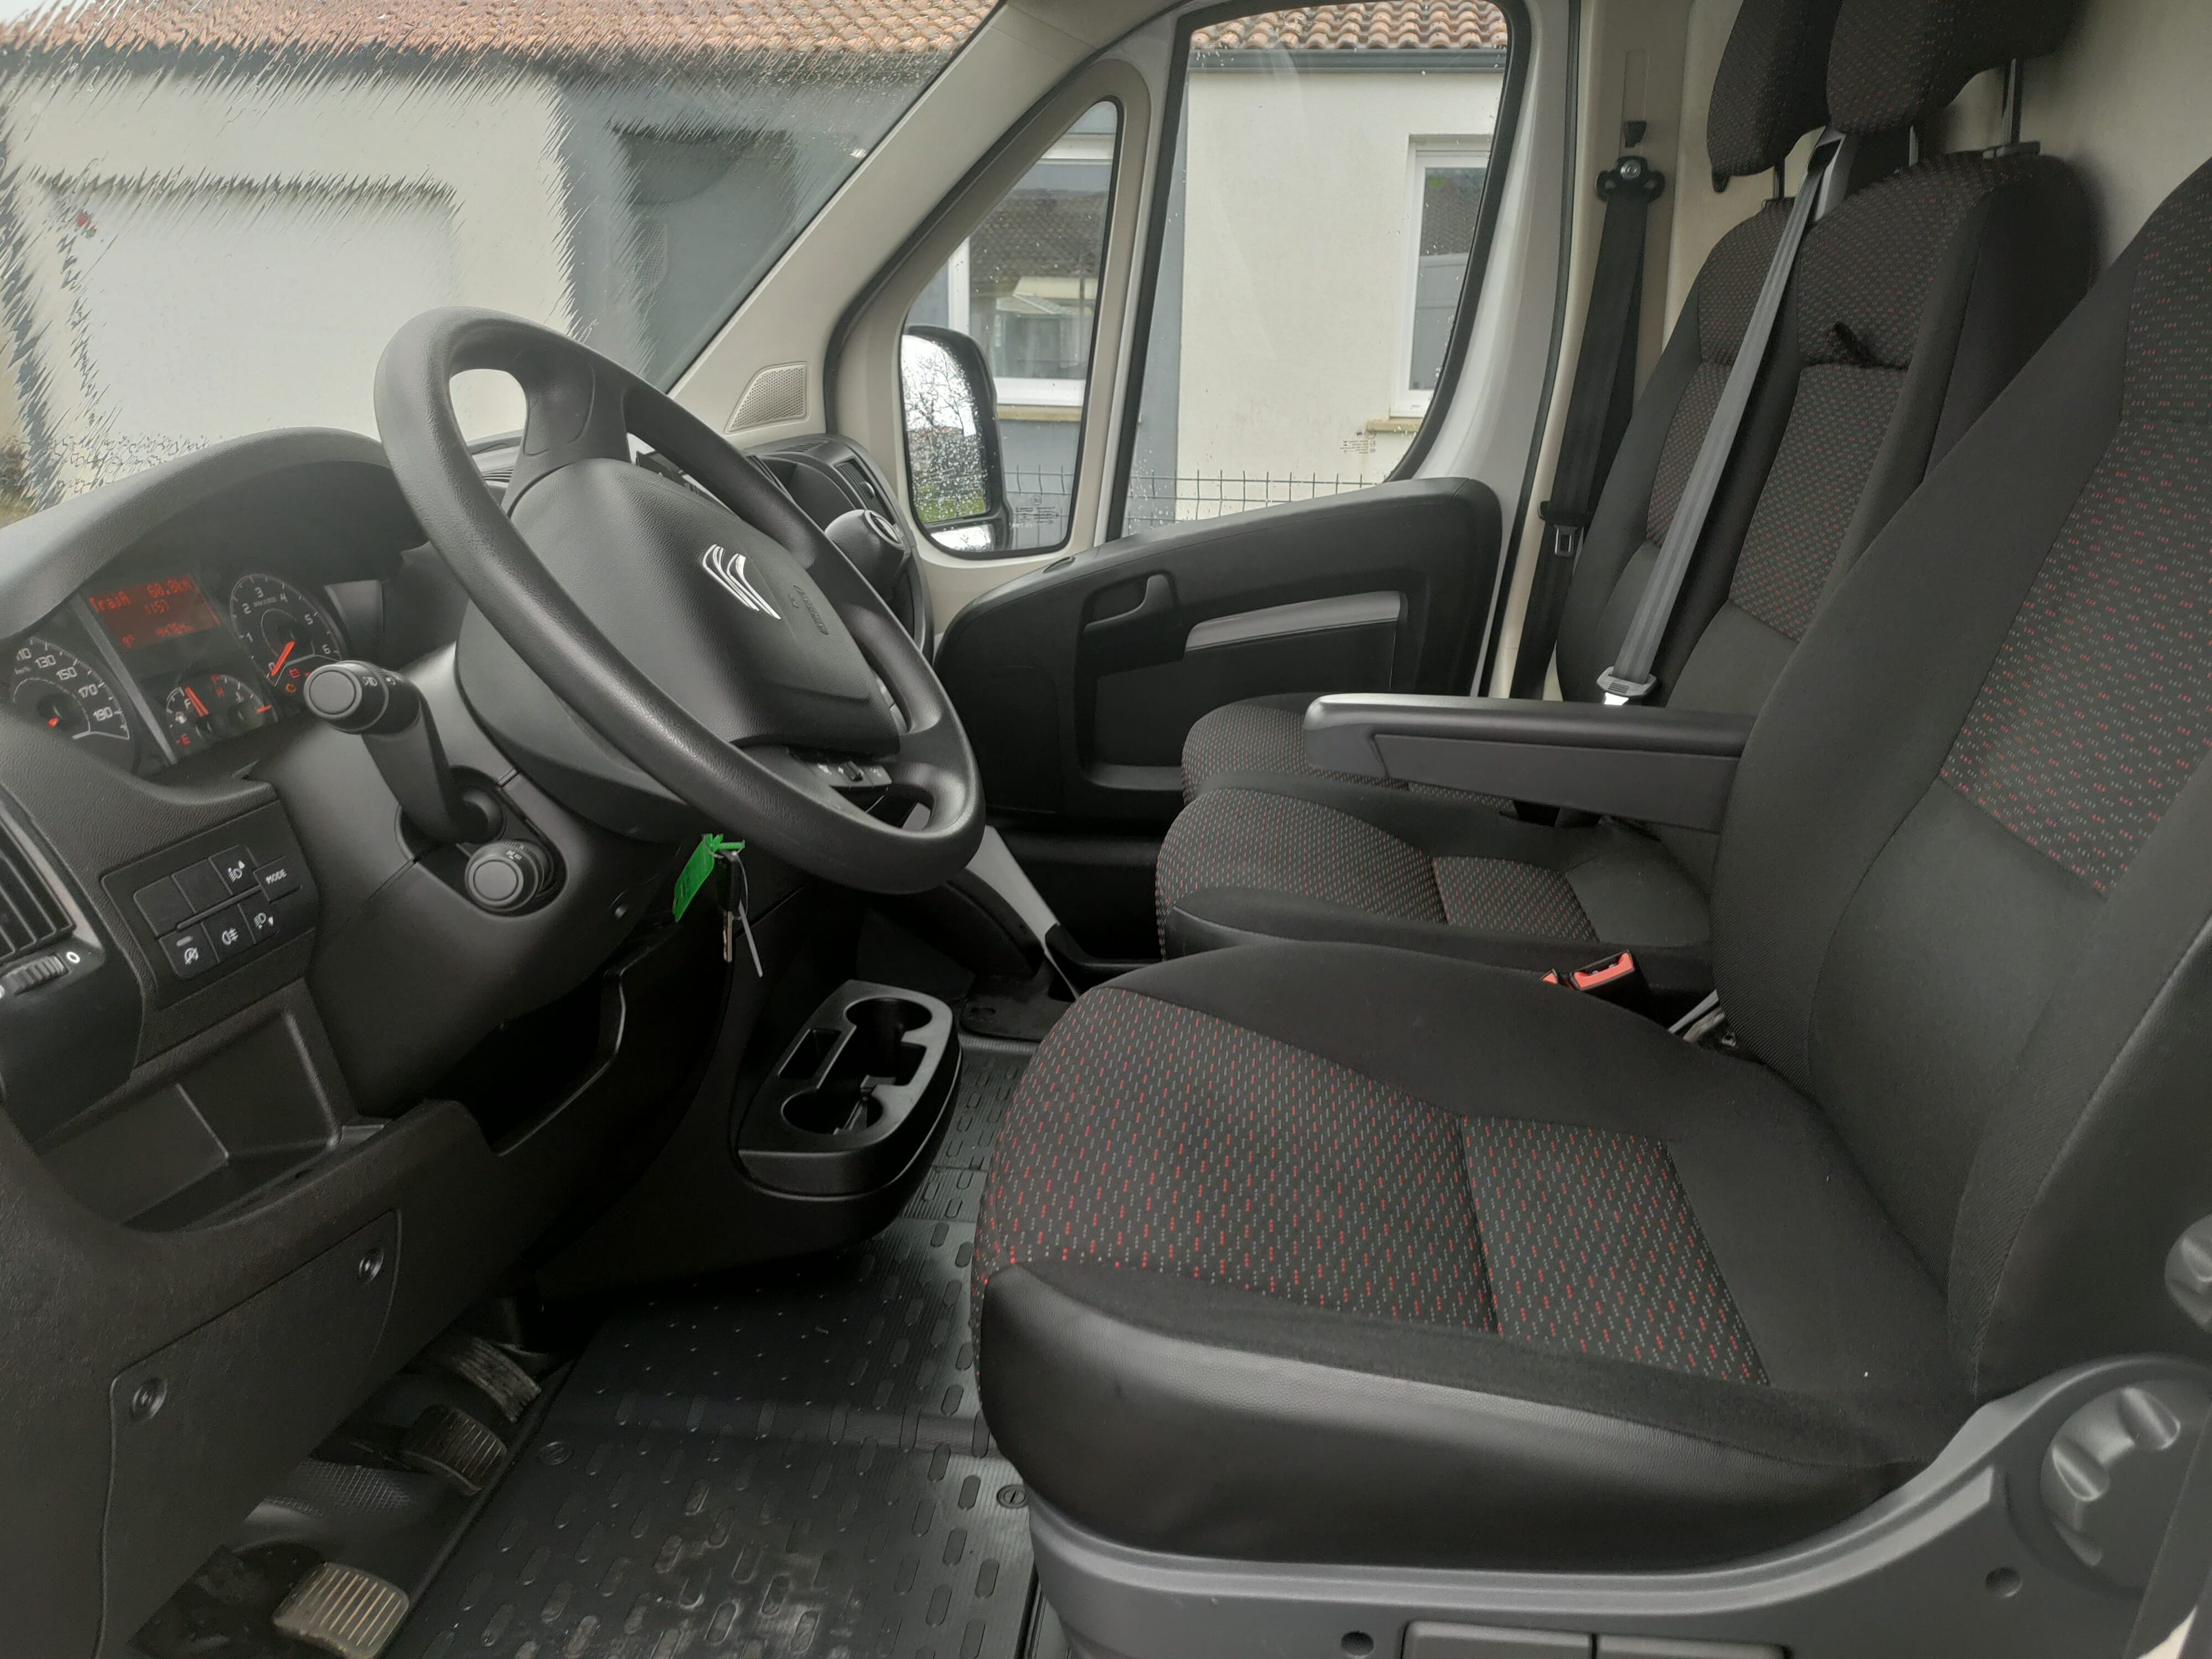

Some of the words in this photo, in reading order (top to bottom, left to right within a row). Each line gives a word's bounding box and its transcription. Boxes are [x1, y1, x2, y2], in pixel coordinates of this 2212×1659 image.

[255, 587, 264, 598] 3
[280, 593, 288, 603] 4
[242, 603, 251, 614] 2
[305, 614, 313, 625] 5
[247, 632, 253, 643] 1
[322, 644, 331, 654] 6
[35, 654, 56, 668] 130
[56, 666, 77, 680] 150
[78, 684, 98, 698] 170
[181, 733, 191, 745] E
[265, 868, 287, 885] MODE
